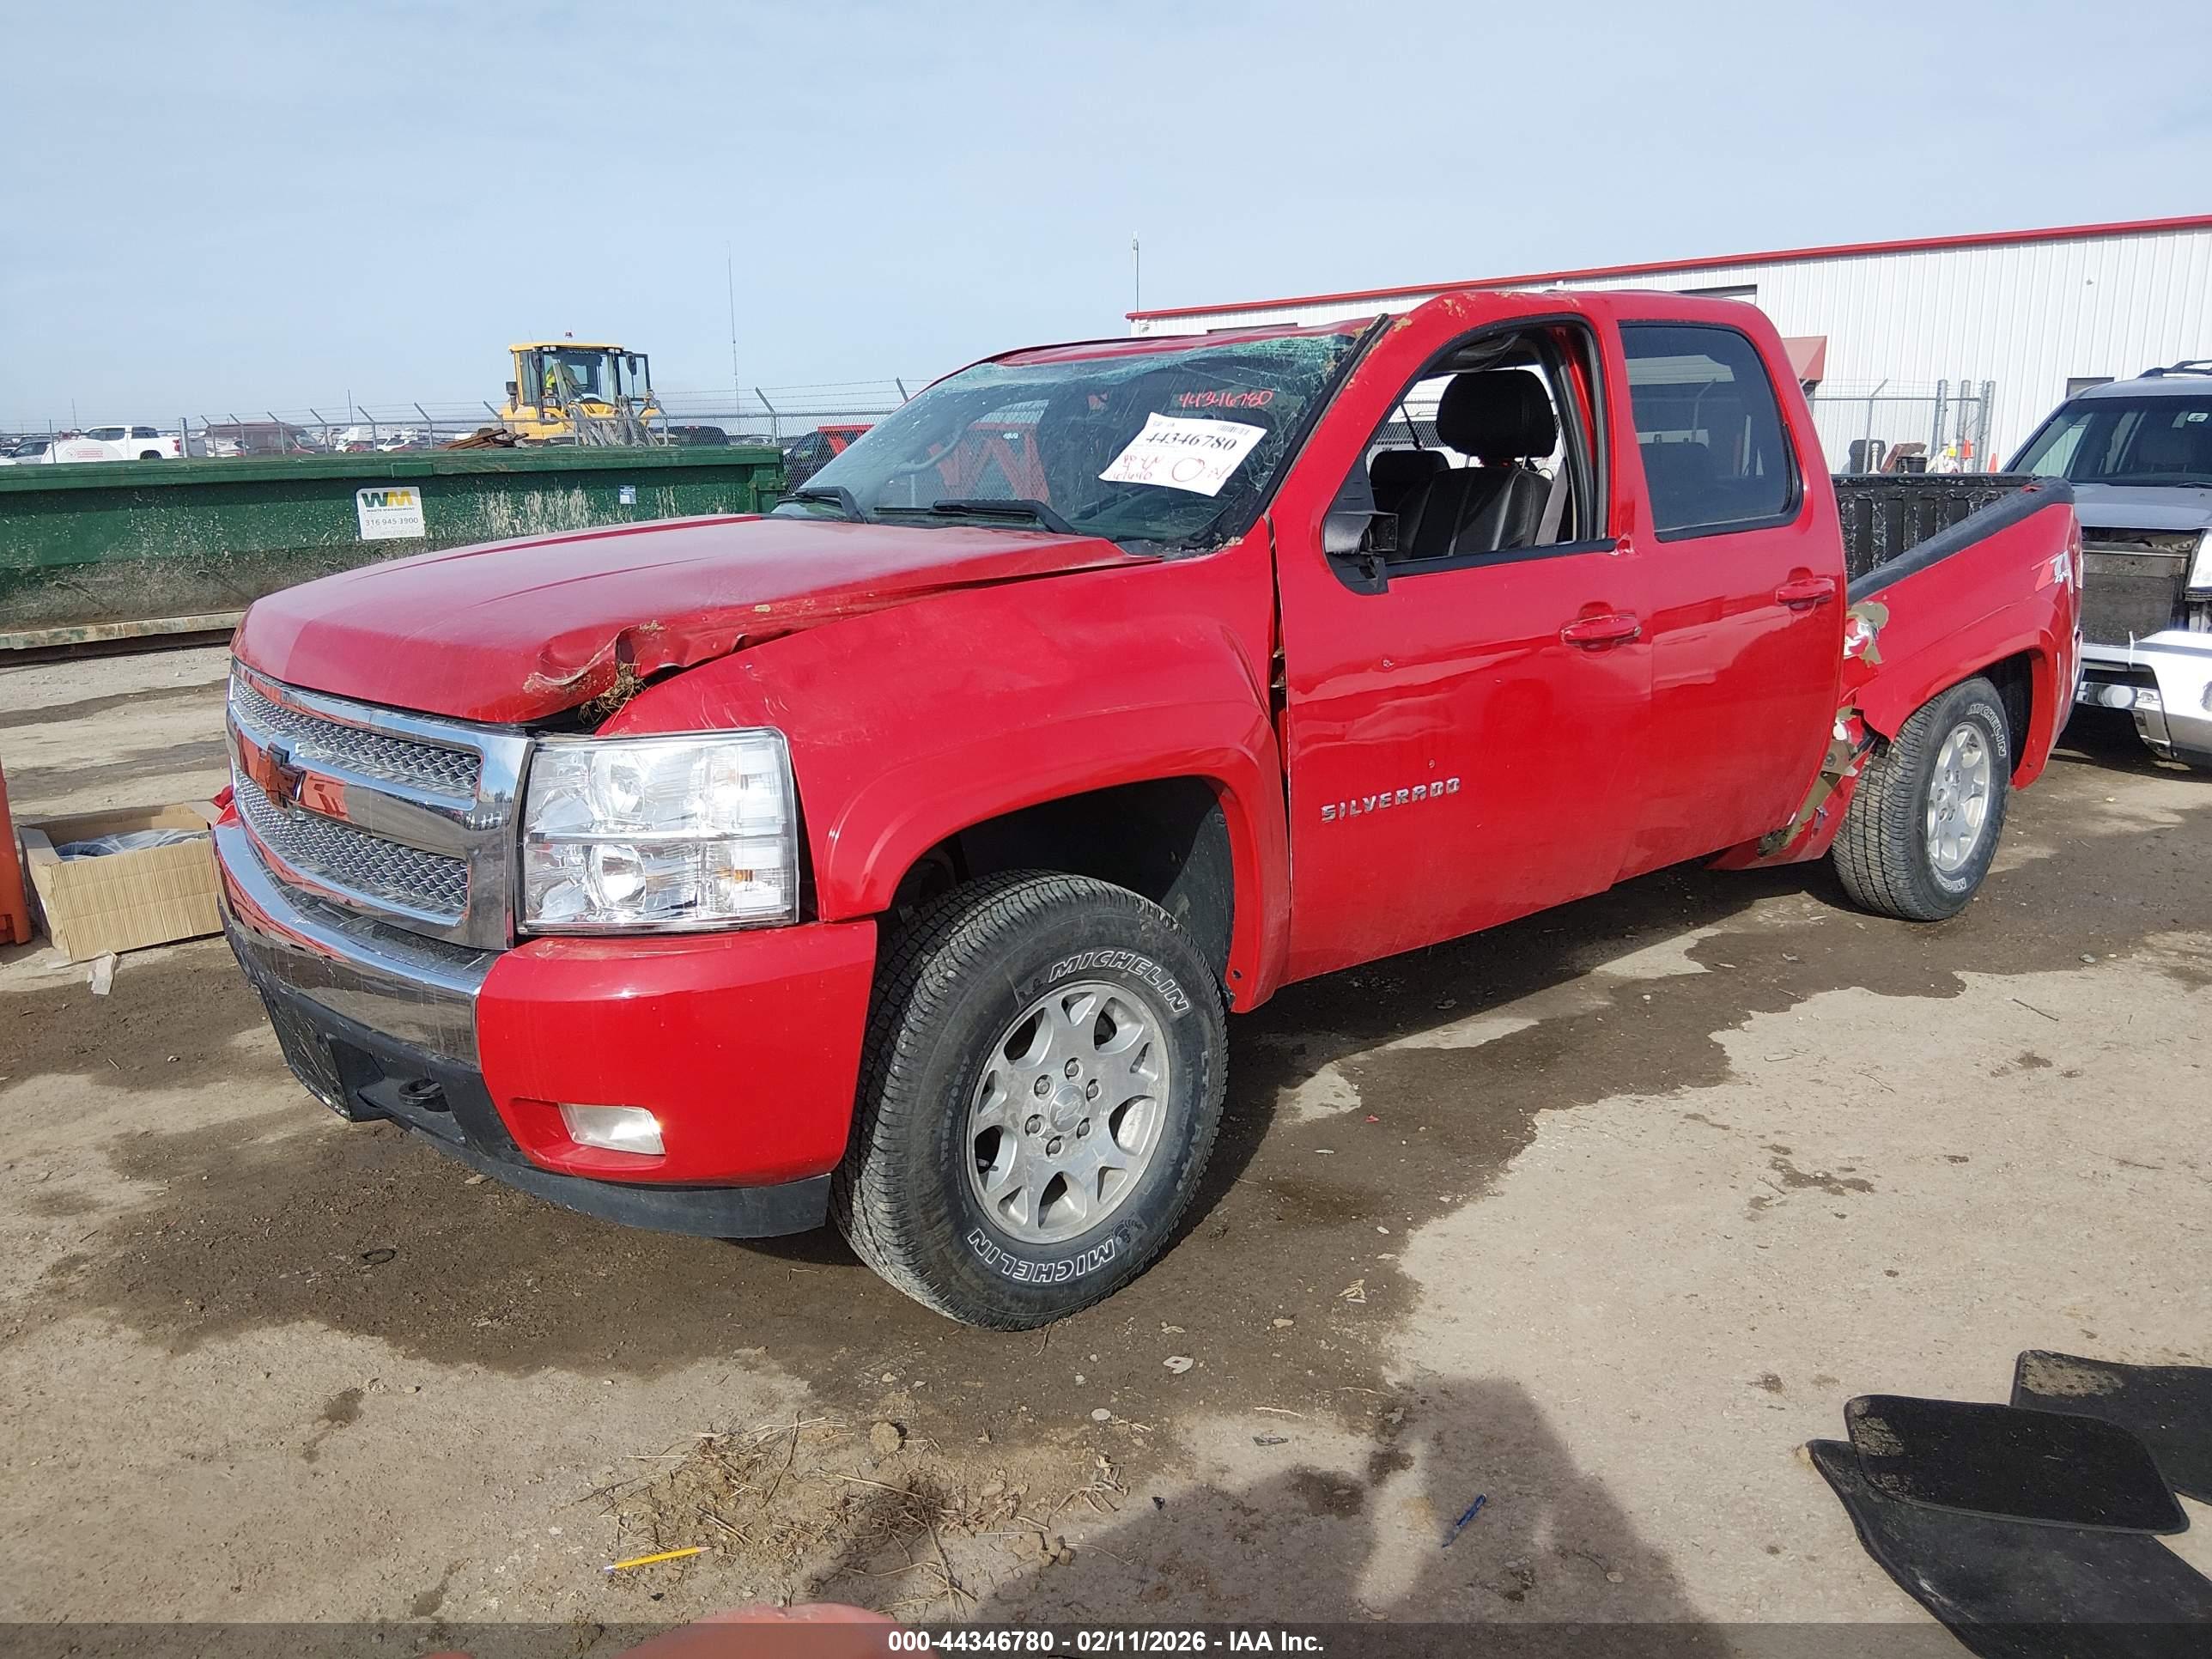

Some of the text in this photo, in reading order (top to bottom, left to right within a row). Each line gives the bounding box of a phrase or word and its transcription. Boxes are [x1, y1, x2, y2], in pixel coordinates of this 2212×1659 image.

[1145, 432, 1237, 451] 44346780
[362, 490, 412, 507] WM
[1966, 703, 2007, 757] MICHELIN
[1321, 777, 1461, 823] SILVERADO
[1048, 951, 1189, 1013] MICHELIN
[967, 1228, 1115, 1283] MICHELIN
